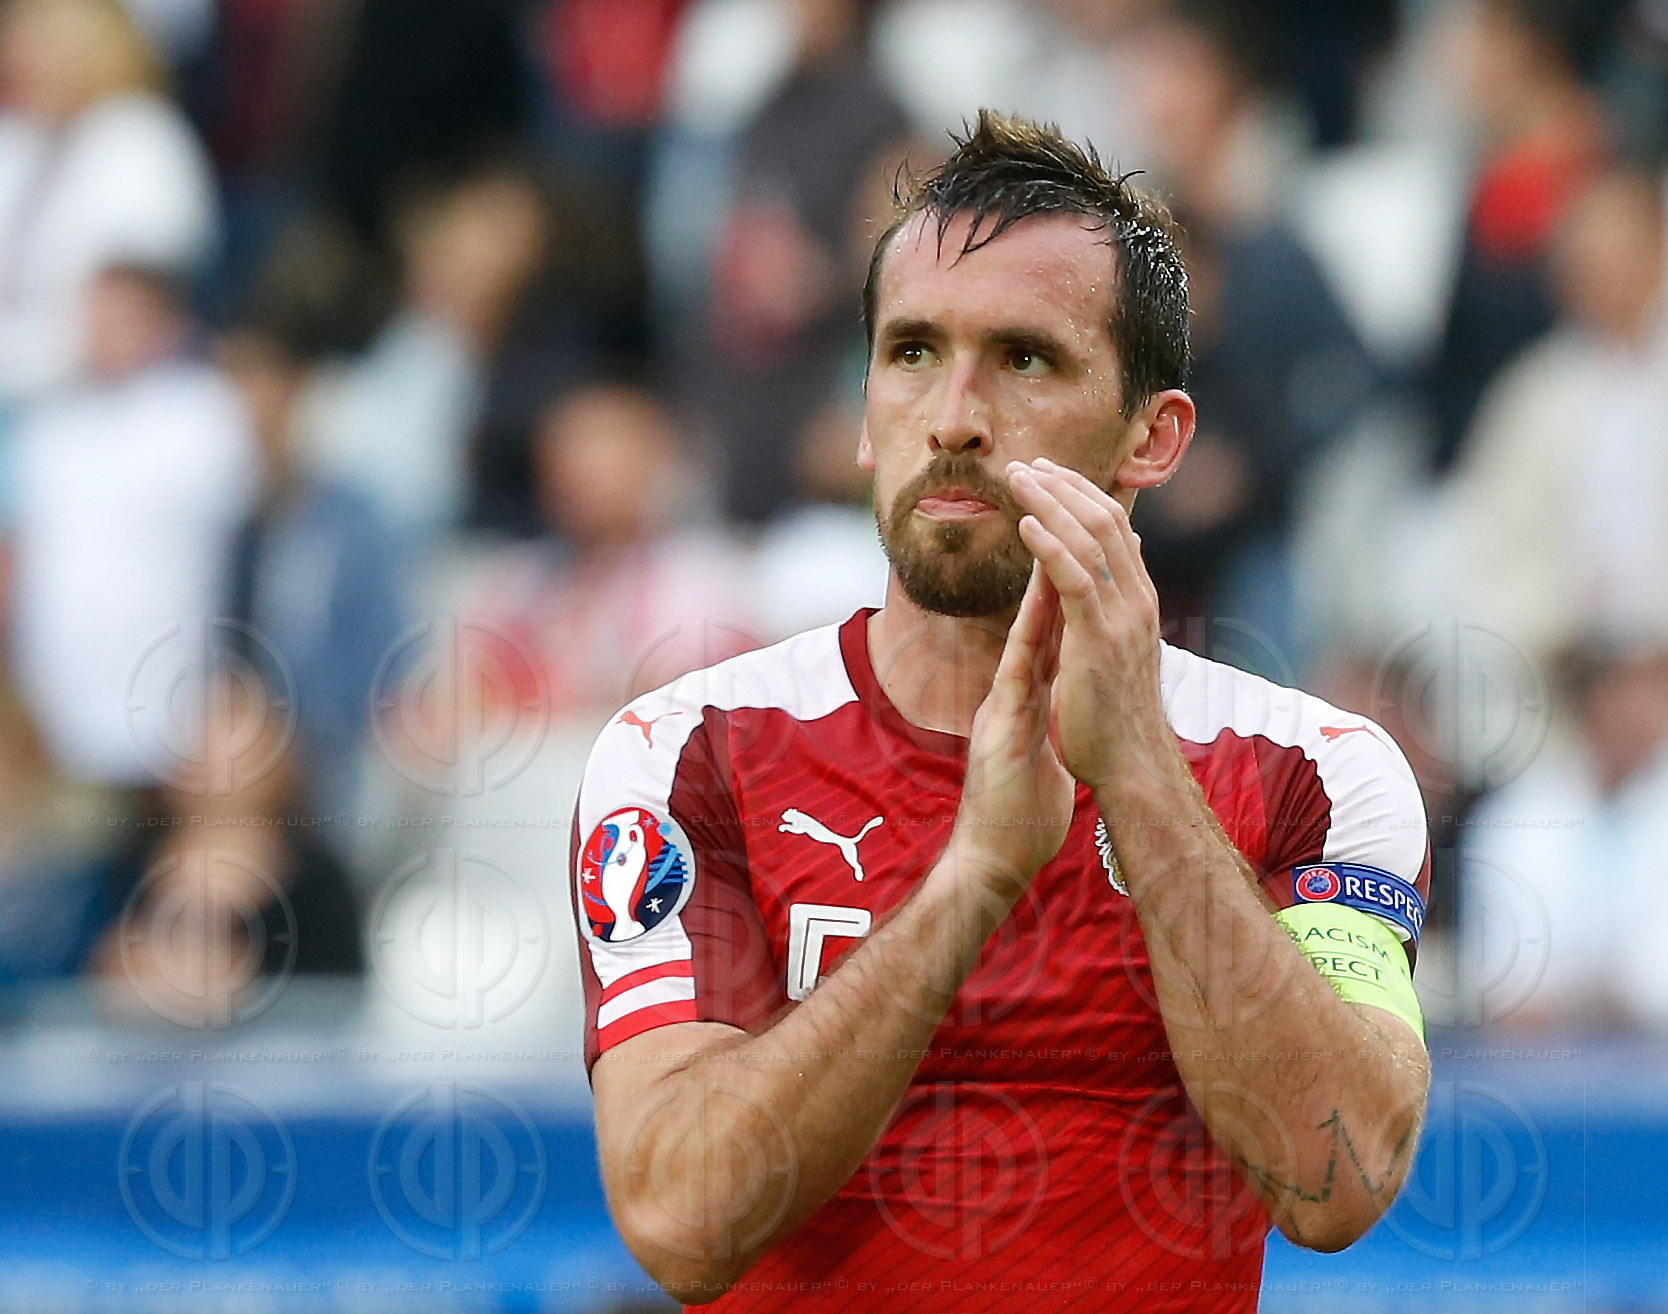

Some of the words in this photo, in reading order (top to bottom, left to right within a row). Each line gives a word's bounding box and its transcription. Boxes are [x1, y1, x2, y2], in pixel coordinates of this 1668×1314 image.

[1345, 876, 1423, 930] RESPEC
[1304, 926, 1392, 964] ACISM
[1311, 956, 1384, 981] PECT
